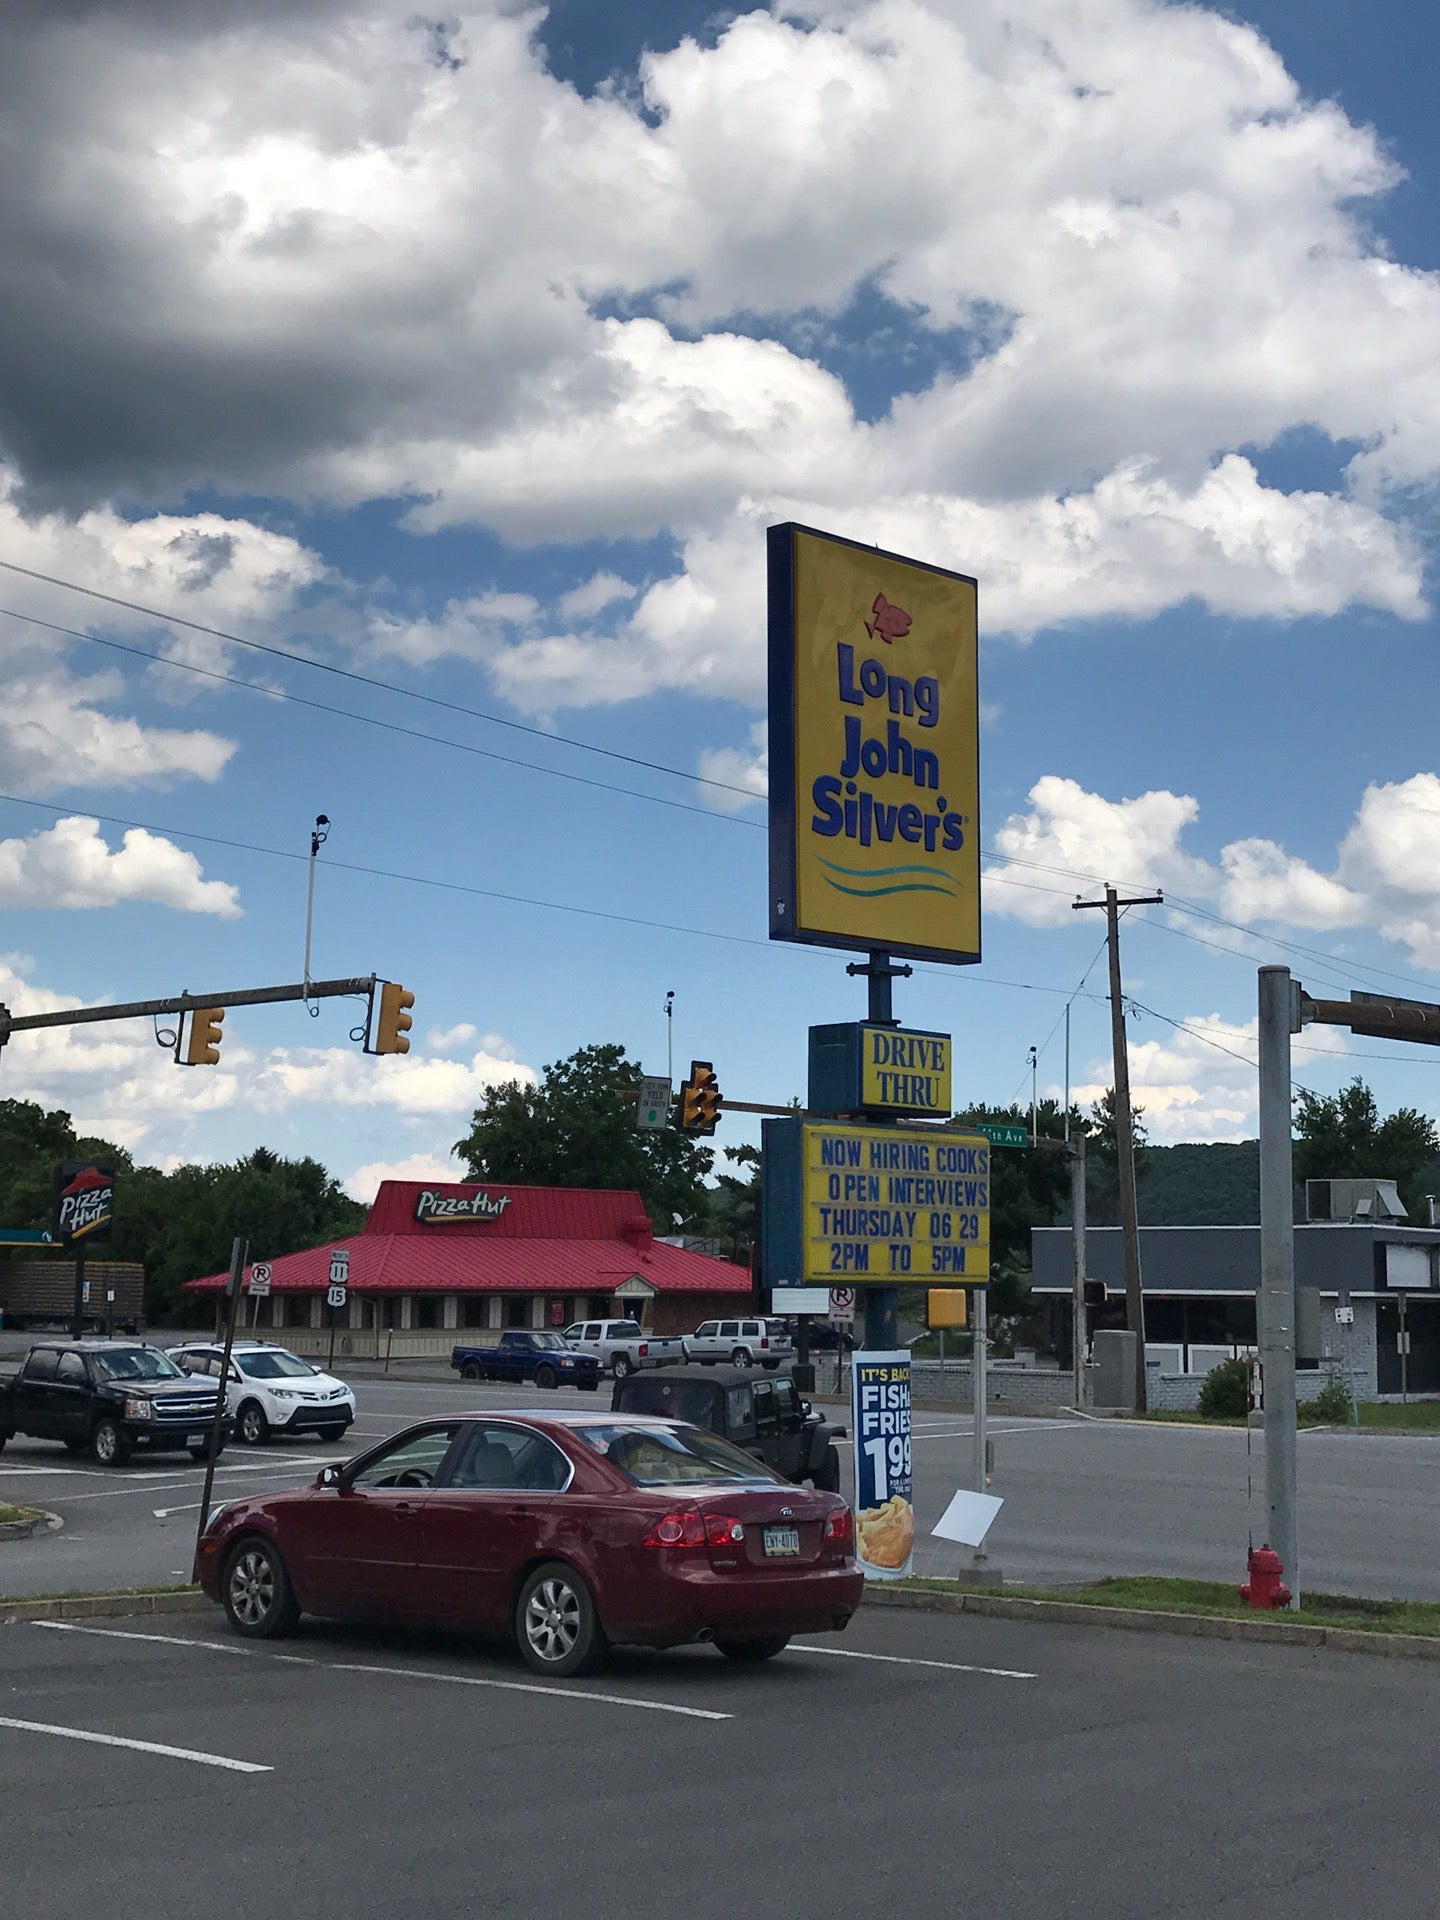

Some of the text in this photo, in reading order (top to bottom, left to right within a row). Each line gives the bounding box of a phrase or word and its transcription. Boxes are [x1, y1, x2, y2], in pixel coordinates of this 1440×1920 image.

[837, 642, 939, 728] Long
[840, 715, 939, 790] John
[812, 775, 964, 852] Silver's
[872, 1033, 945, 1072] DRIVE
[876, 1070, 940, 1108] THRU
[1005, 1130, 1023, 1143] Ave
[821, 1139, 988, 1175] NOW HIRING COOKS
[60, 1188, 113, 1225] Pizza
[417, 1190, 512, 1217] Pizza Hut
[828, 1173, 988, 1208] OPEN INTERVIEWS
[70, 1203, 108, 1231] Hut
[819, 1208, 979, 1240] THURSDAY 06 29
[334, 1266, 344, 1279] 11
[830, 1243, 966, 1273] 2PM TO 5PM
[331, 1290, 343, 1303] 15
[861, 1368, 888, 1382] IT'S
[862, 1411, 911, 1436] FRIES
